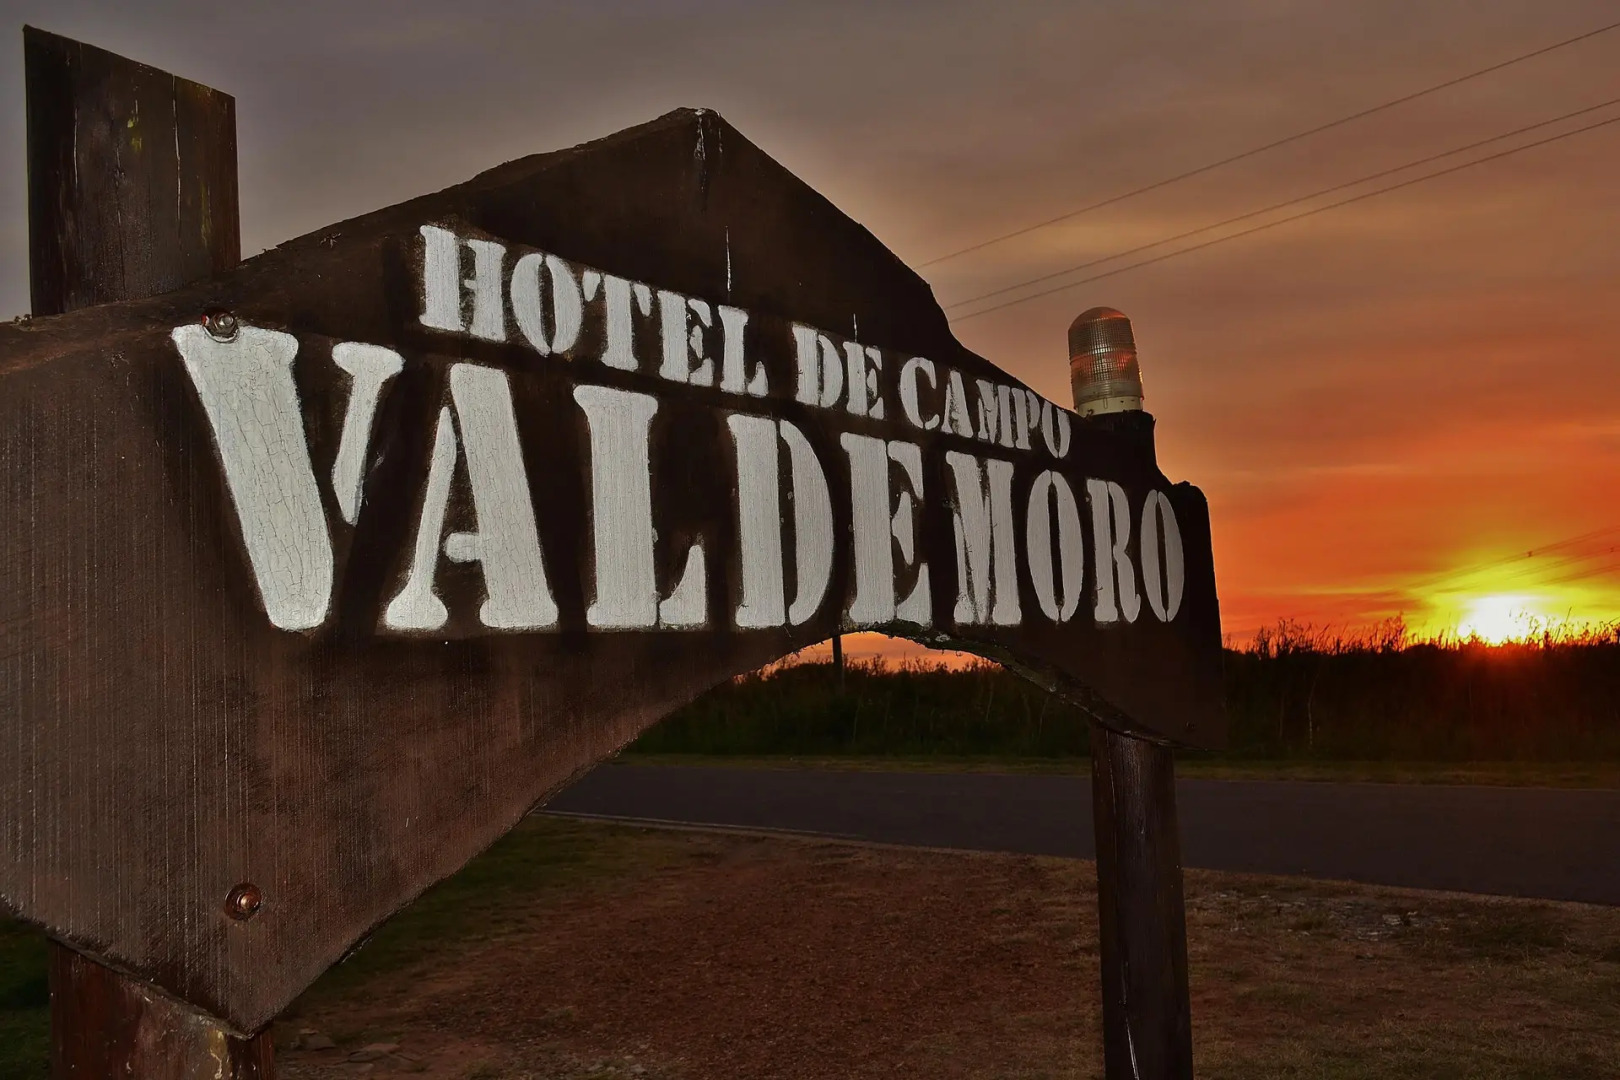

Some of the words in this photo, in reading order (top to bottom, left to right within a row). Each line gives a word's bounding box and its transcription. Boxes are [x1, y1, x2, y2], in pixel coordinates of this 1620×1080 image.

[171, 323, 1185, 629] VALDEMORO
[418, 225, 769, 398] HOTEL
[791, 323, 885, 420] DE
[899, 356, 1072, 459] CAMPO
